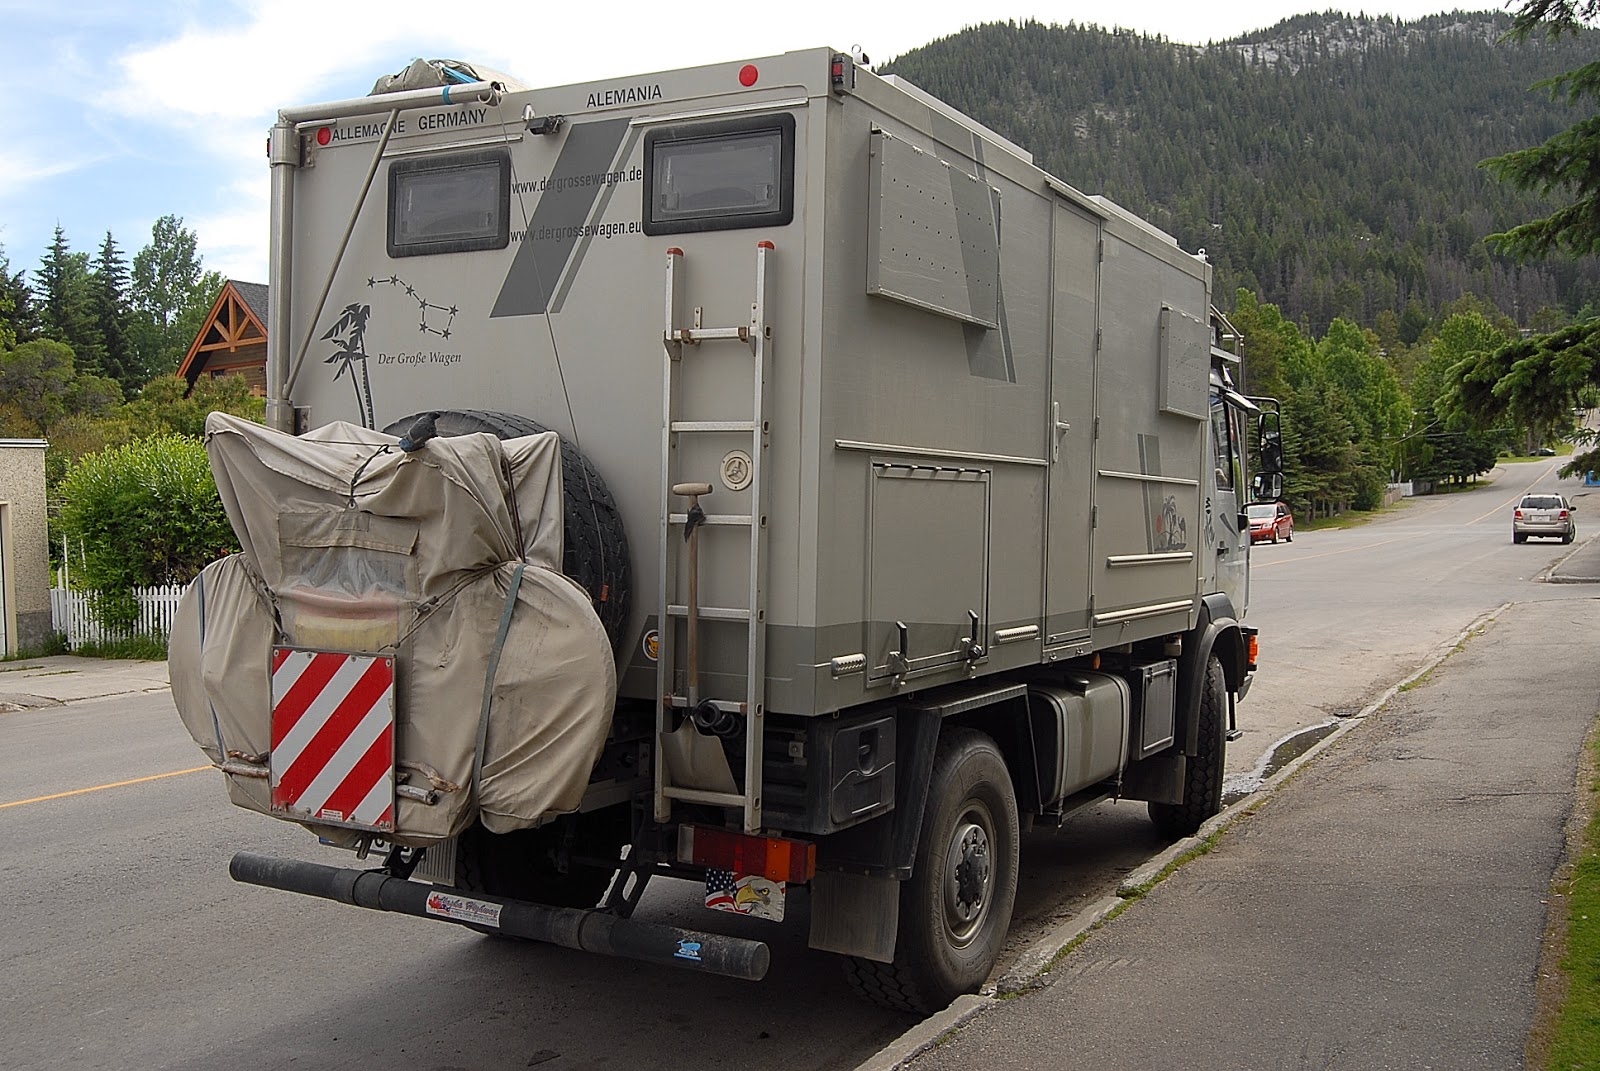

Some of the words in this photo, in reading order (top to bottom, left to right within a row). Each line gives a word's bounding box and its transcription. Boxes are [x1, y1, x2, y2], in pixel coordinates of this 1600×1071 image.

[586, 84, 663, 109] ALEMANIA
[418, 107, 488, 131] GERMANY
[511, 165, 643, 195] www.dergrossewagen.de
[510, 221, 642, 243] www.dergrossewagen.eu
[378, 352, 396, 365] Der
[397, 352, 427, 368] Große
[429, 351, 462, 367] Wagen
